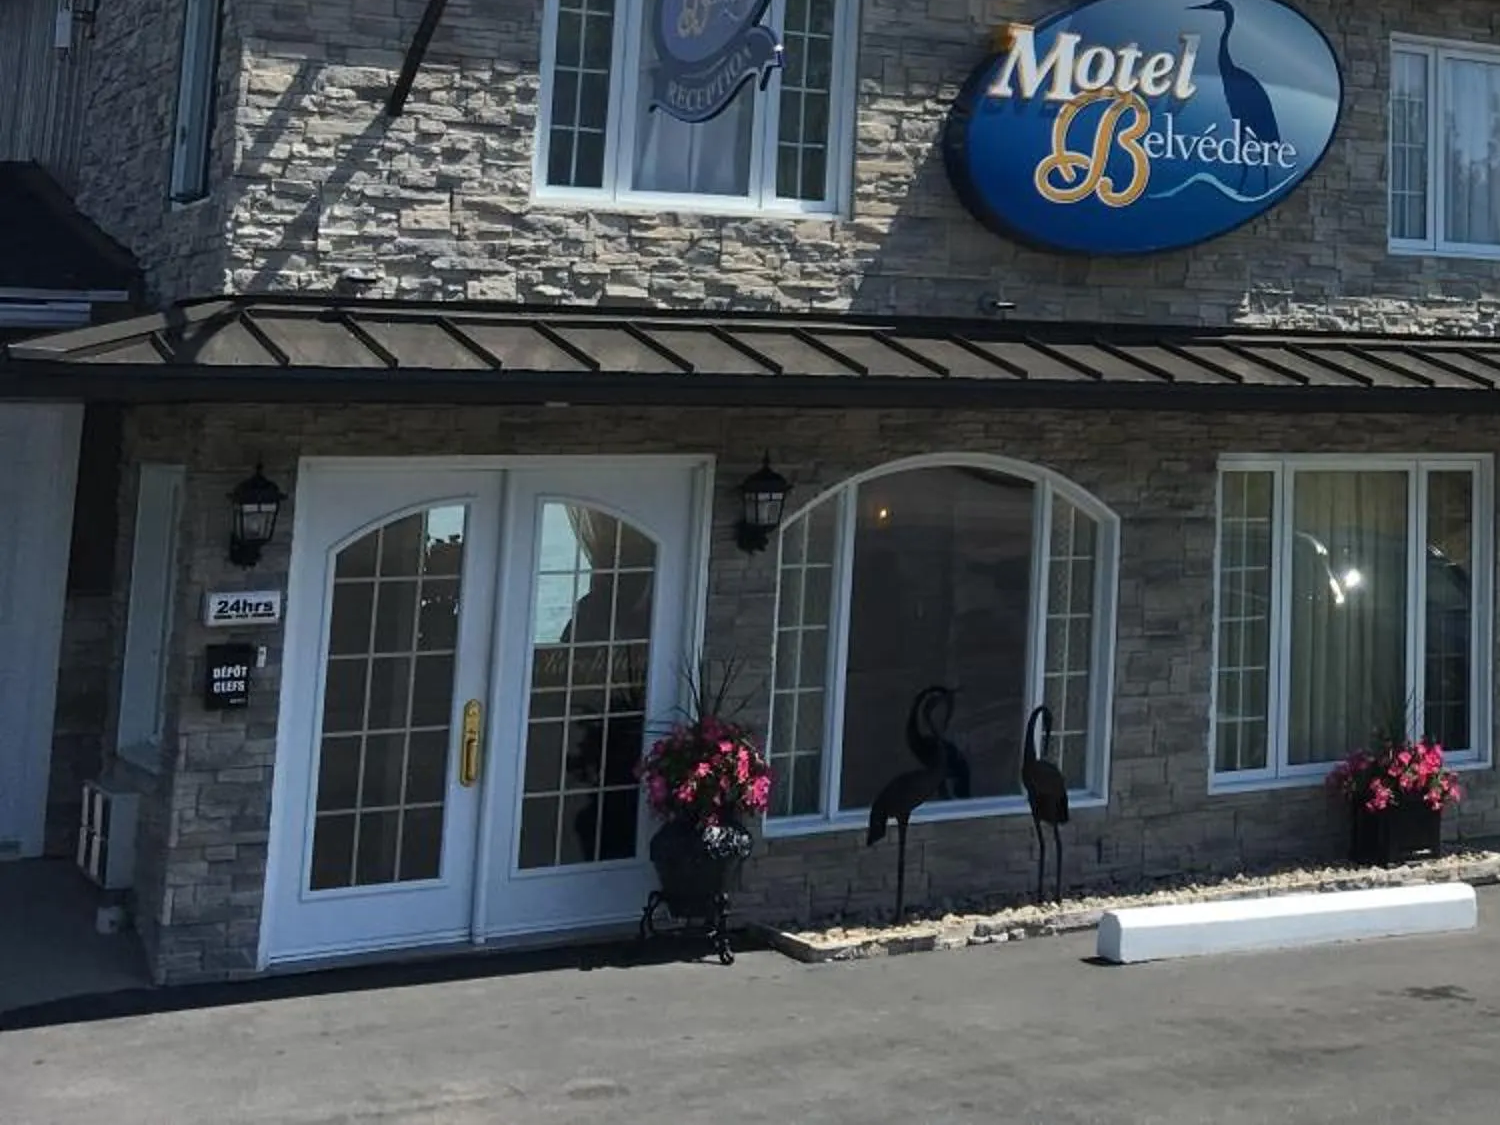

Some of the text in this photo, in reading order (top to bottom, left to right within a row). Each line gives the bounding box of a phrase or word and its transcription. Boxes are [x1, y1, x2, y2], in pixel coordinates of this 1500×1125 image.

[985, 23, 1200, 101] Motel
[1034, 88, 1298, 207] Belvédère
[217, 599, 273, 613] 24hrs
[213, 681, 245, 693] CLEFS
